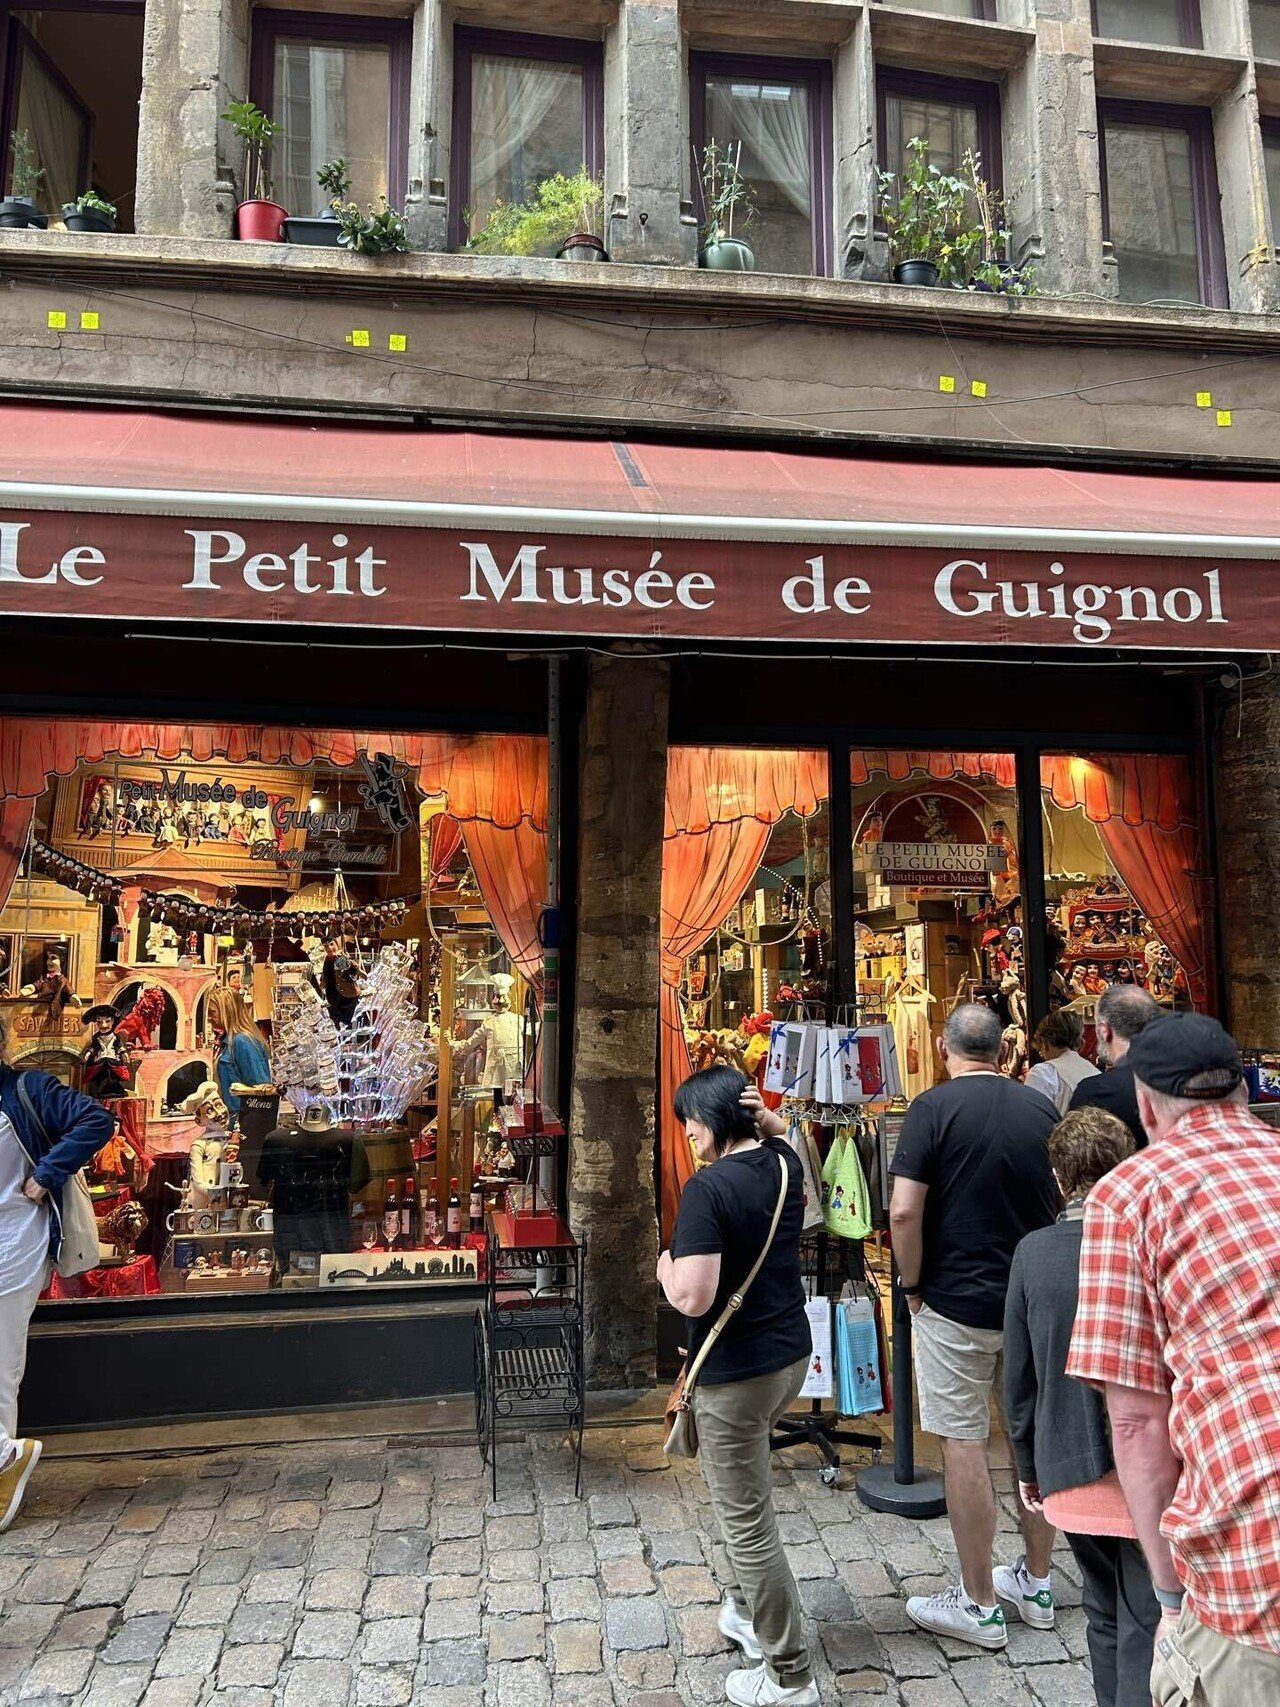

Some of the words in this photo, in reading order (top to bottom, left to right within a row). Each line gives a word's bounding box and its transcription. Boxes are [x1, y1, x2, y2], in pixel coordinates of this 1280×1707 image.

[0, 522, 107, 587] Le
[181, 529, 389, 599] Petit
[459, 541, 716, 610] Musée
[780, 554, 872, 615] de
[933, 559, 1230, 644] Guignol
[119, 781, 156, 800] Petit
[159, 768, 236, 803] Musée
[242, 785, 268, 808] de
[271, 797, 359, 837] Guignol
[865, 842, 885, 855] LE
[892, 844, 939, 857] PETIT
[879, 857, 901, 869] DE
[909, 858, 991, 870] GUIGNOL
[886, 871, 935, 885] Boutique
[937, 873, 948, 882] et
[950, 872, 985, 884] Musée
[245, 1097, 272, 1109] Menu
